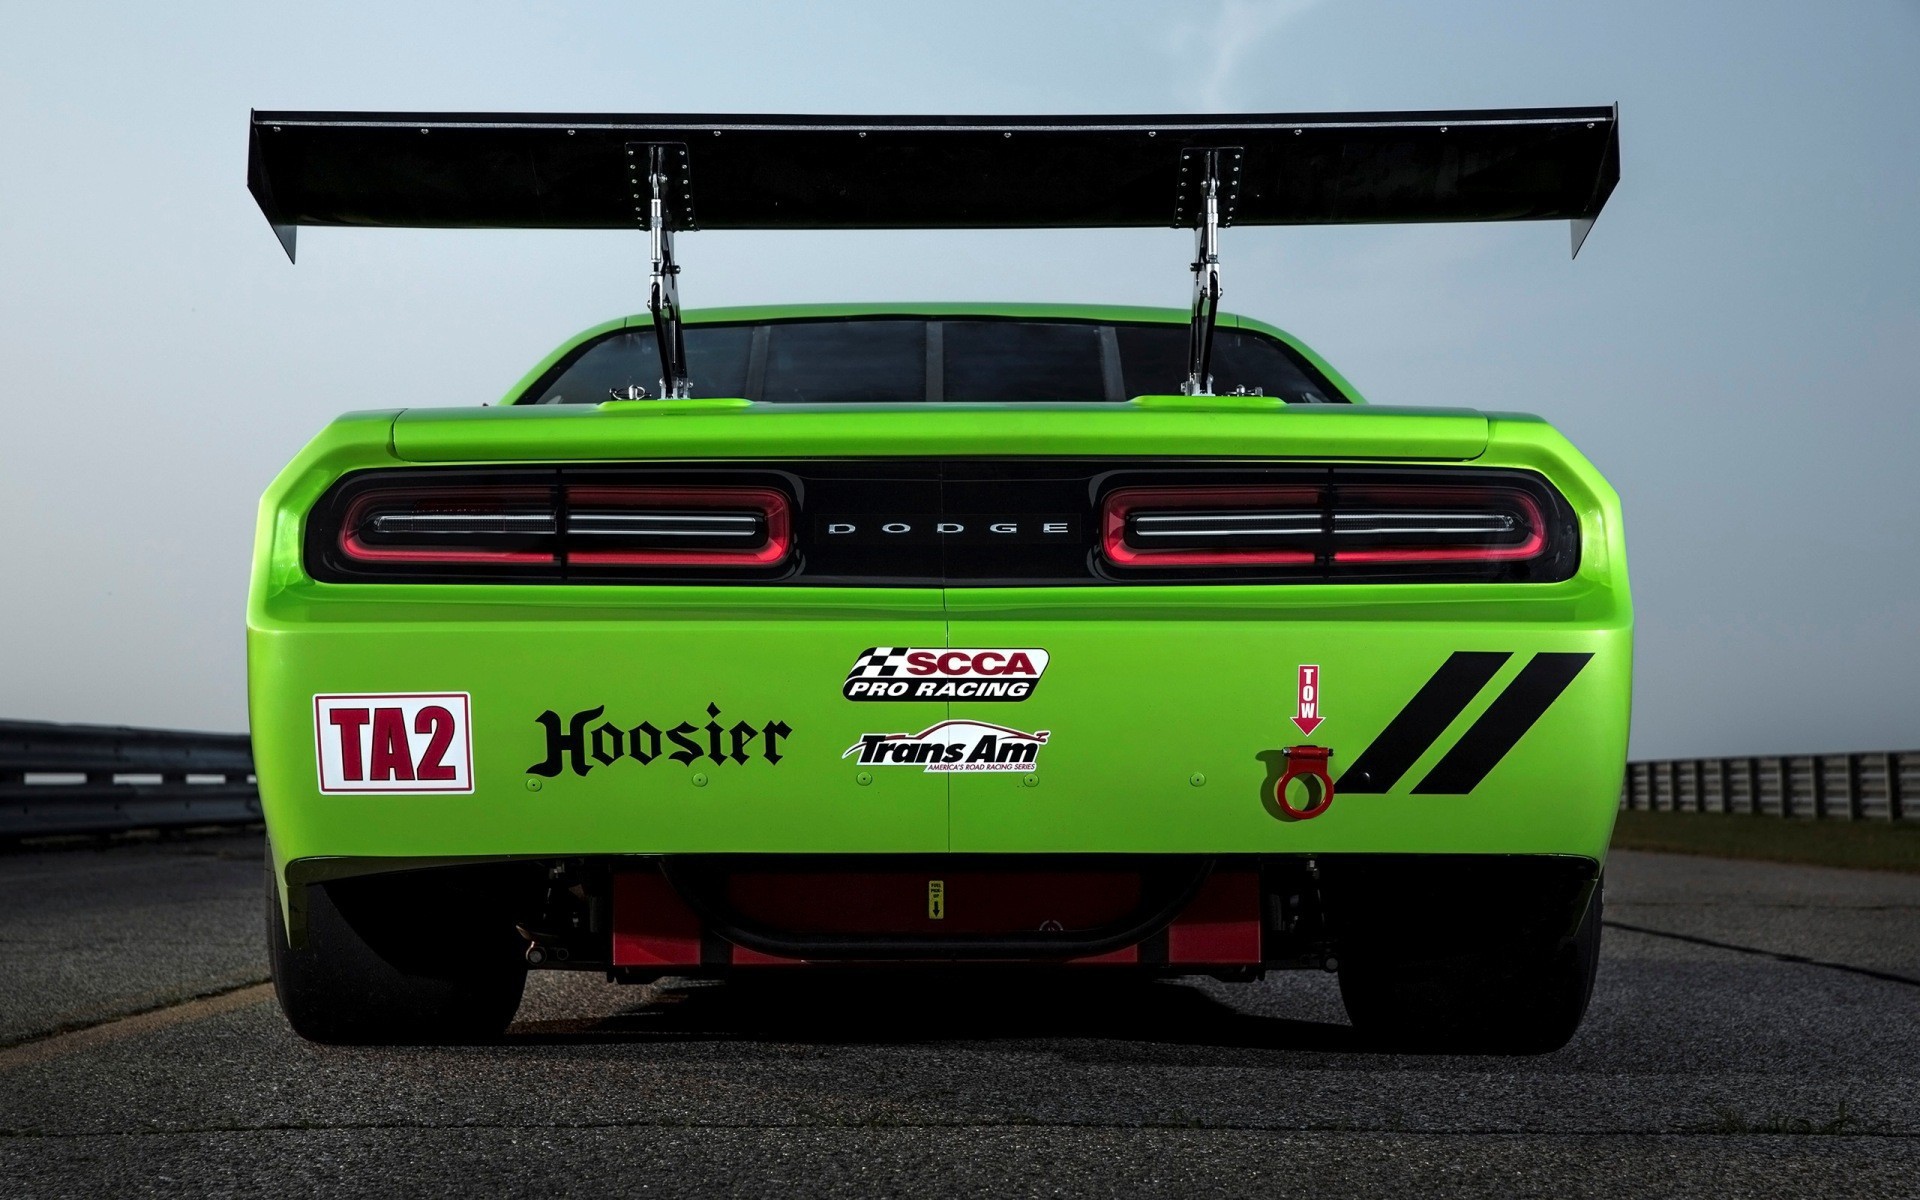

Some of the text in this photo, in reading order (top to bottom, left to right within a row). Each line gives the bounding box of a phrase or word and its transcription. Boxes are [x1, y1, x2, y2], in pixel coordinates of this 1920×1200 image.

[828, 523, 1069, 534] DODGE
[906, 652, 1038, 676] SCCA
[849, 682, 1030, 697] PRO RACING
[1301, 668, 1315, 718] TOW
[329, 705, 457, 781] TA2
[525, 701, 793, 778] Hoosier
[860, 734, 1038, 763] Trans Am
[928, 763, 964, 771] AMERICA'S
